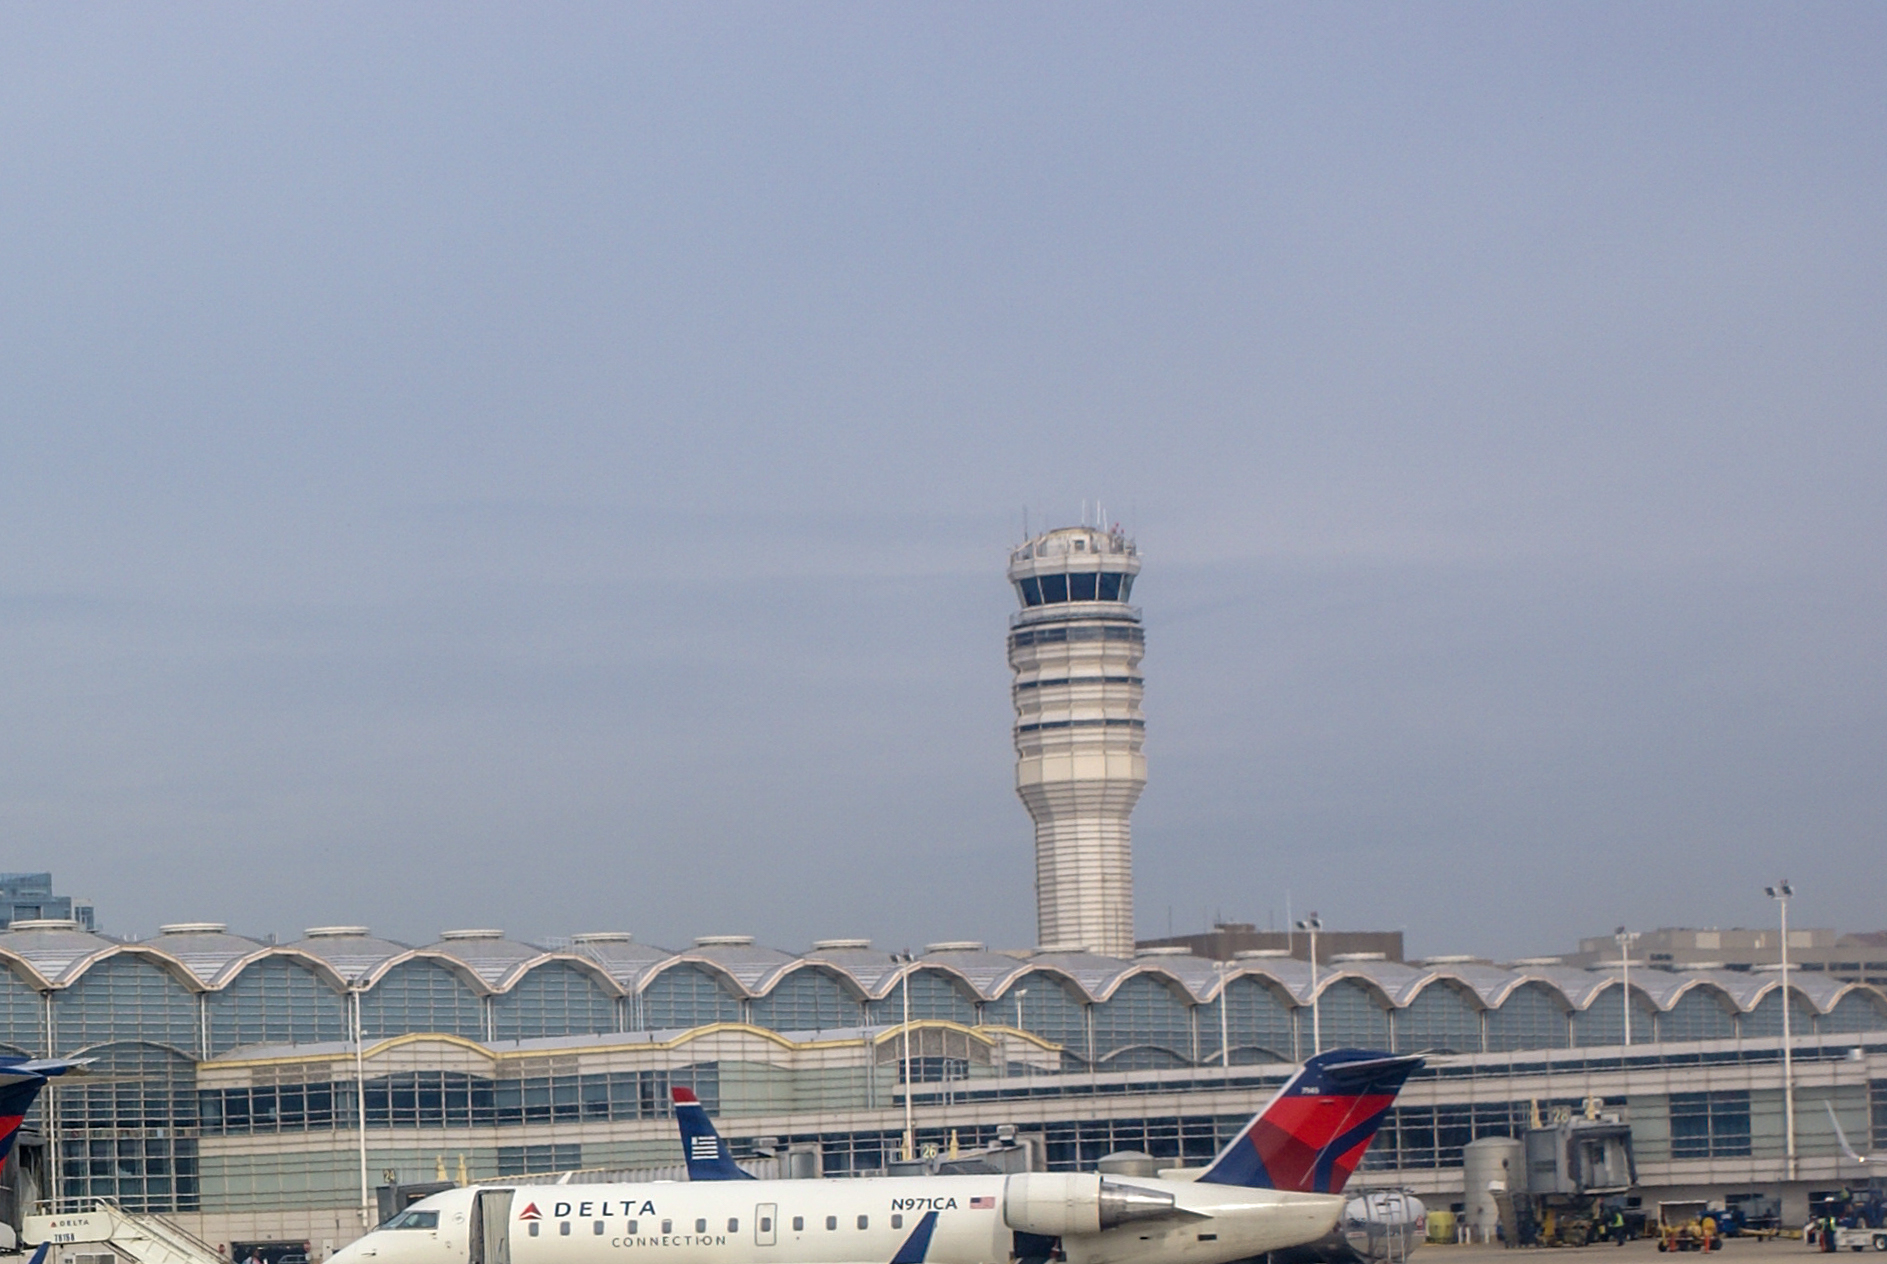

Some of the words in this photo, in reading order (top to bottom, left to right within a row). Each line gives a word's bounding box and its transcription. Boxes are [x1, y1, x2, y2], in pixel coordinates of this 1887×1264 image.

[922, 1144, 937, 1159] 26
[384, 1169, 396, 1183] 24
[554, 1200, 656, 1217] DELTA
[891, 1197, 958, 1210] N971CA
[59, 1219, 89, 1227] DELTA
[612, 1236, 725, 1248] CONNECTION
